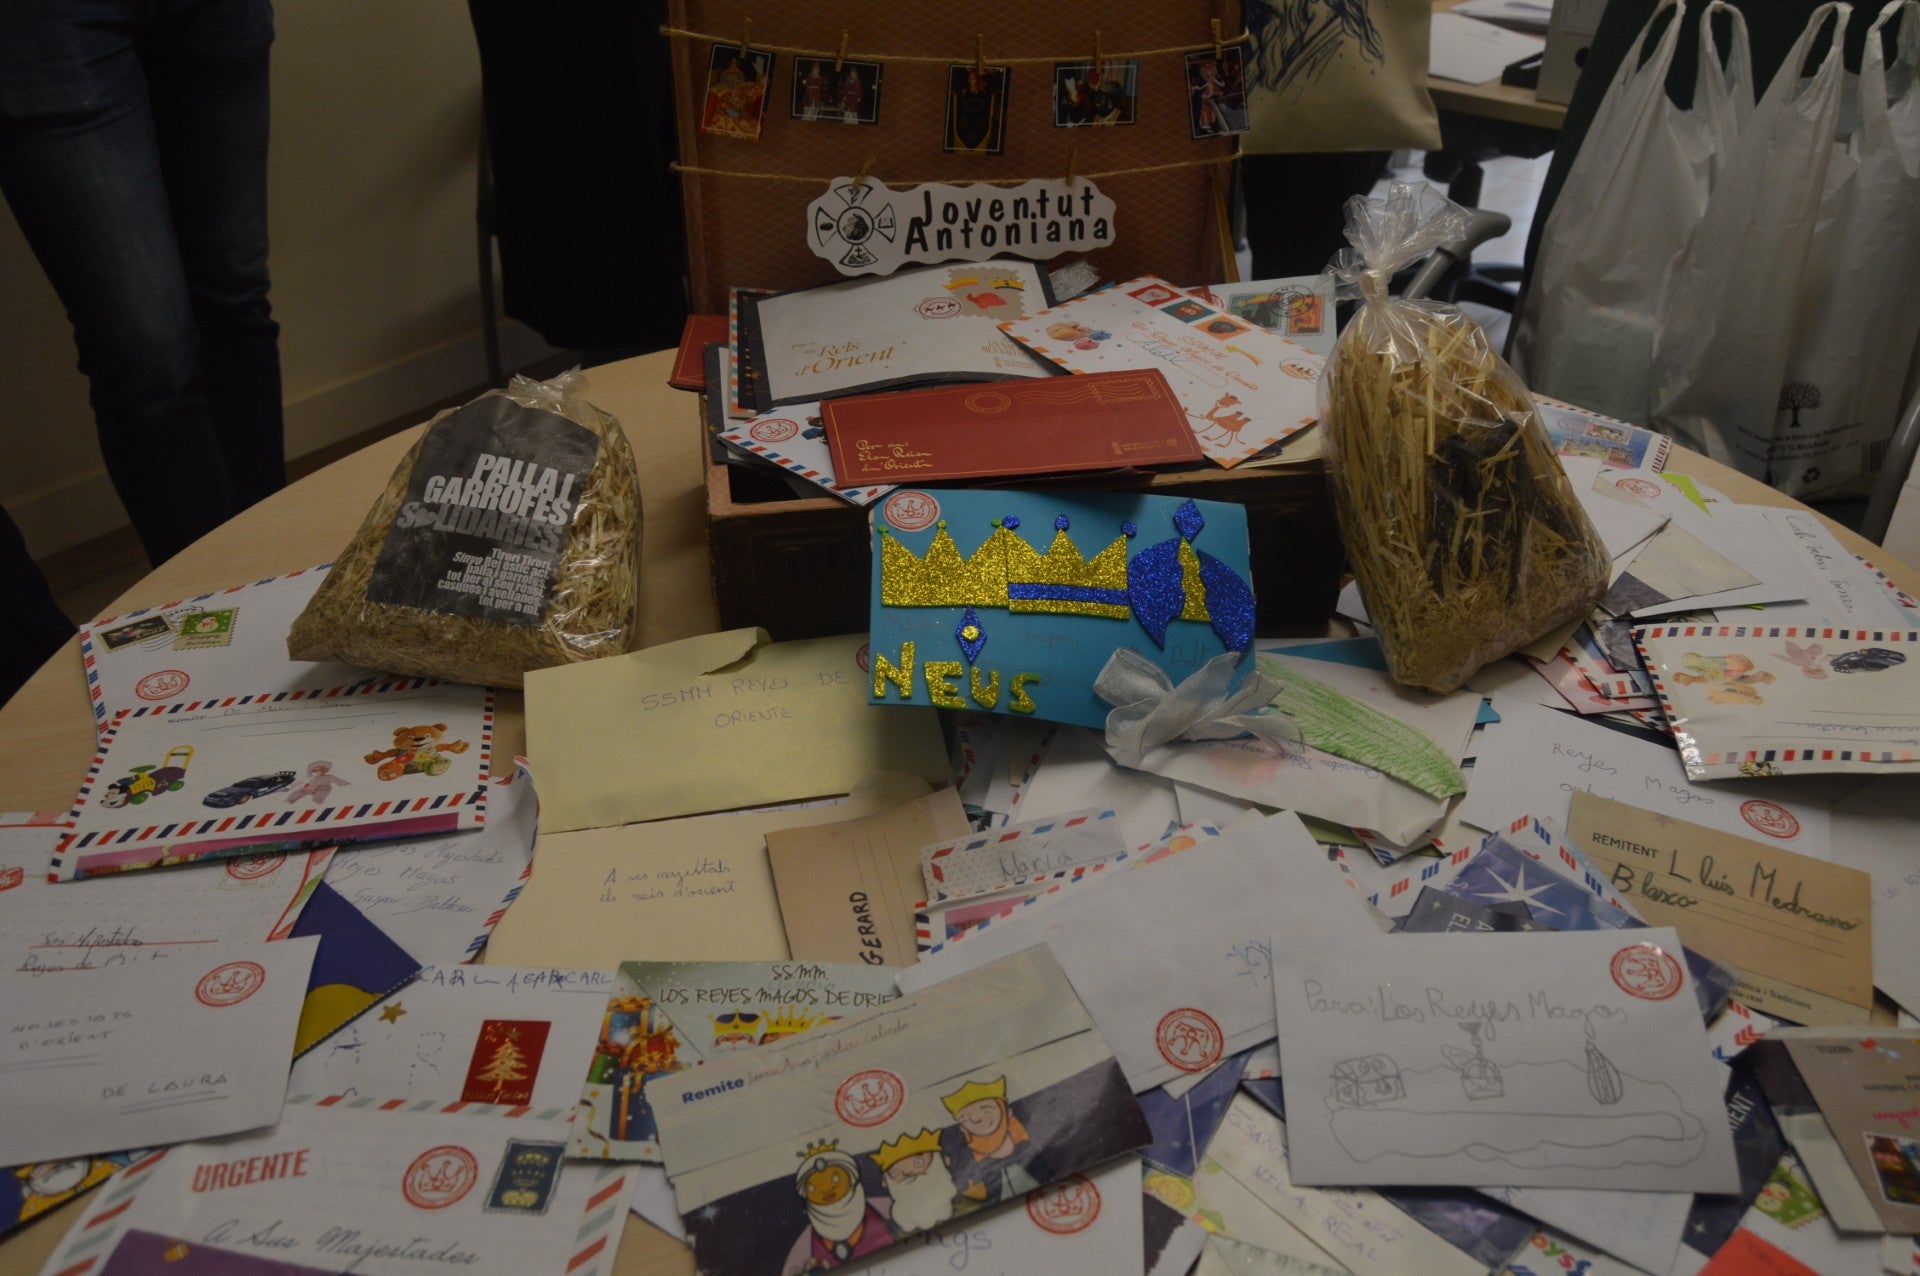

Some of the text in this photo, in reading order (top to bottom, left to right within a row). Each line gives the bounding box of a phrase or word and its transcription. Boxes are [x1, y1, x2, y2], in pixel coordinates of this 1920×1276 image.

[921, 186, 1094, 227] Joventut
[904, 212, 1108, 255] Antoniana
[471, 454, 559, 501] PALLA
[423, 475, 572, 526] GARROFES
[437, 579, 483, 595] casques
[447, 570, 462, 581] tot
[462, 573, 483, 585] per
[494, 579, 515, 591] seu
[466, 564, 493, 577] palla
[478, 594, 493, 606] tot
[494, 598, 515, 610] per
[641, 683, 713, 711] SSMM
[816, 670, 848, 686] DE
[873, 641, 1042, 714] NEUS
[714, 707, 794, 729] ORIENTE
[1553, 742, 1618, 775] Reyes
[1592, 832, 1659, 859] REMITENT
[399, 866, 461, 892] Magos
[1611, 862, 1698, 909] Blasco
[1750, 860, 1862, 931] Medrano
[849, 892, 884, 966] GERARD
[660, 988, 688, 1004] LOS
[694, 987, 752, 1005] REYES
[825, 989, 851, 1005] DE
[1425, 987, 1520, 1042] Reyes
[1527, 989, 1629, 1040] Magos
[102, 1073, 228, 1100] DE LAURA
[682, 1077, 745, 1104] Remite
[192, 1148, 310, 1194] URGENTE
[236, 1219, 300, 1248] Sus
[316, 1226, 481, 1274] Majestades
